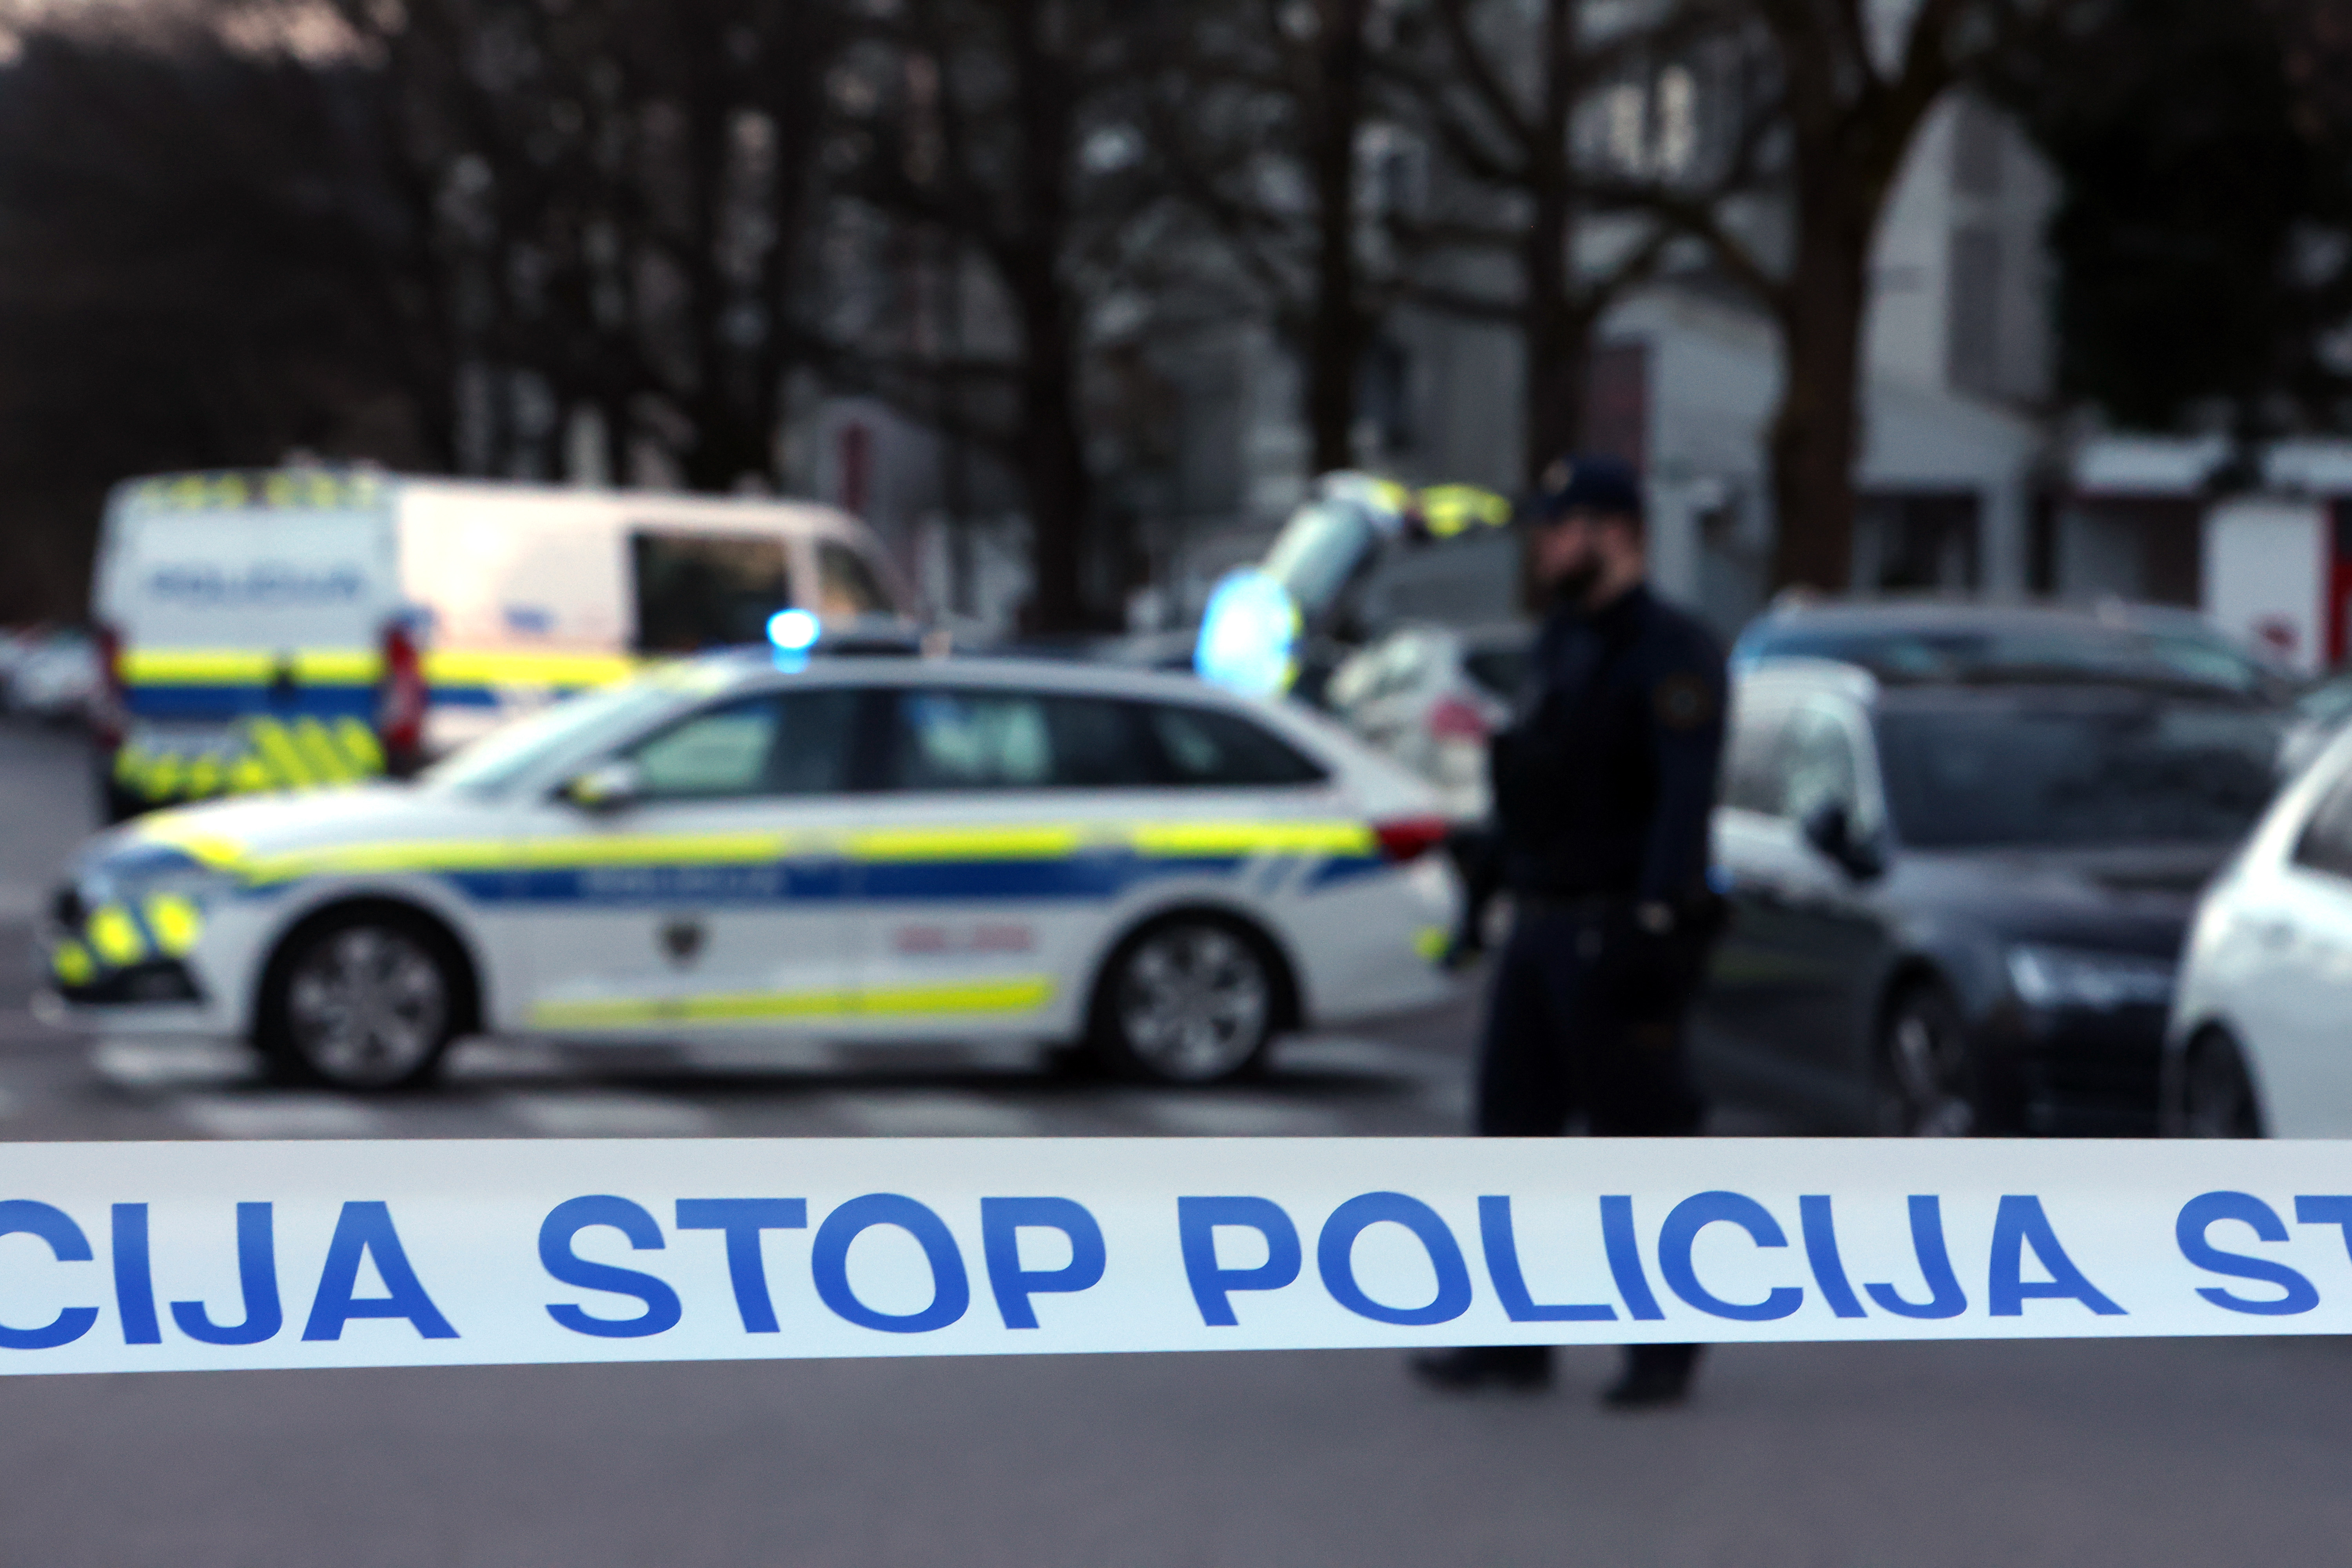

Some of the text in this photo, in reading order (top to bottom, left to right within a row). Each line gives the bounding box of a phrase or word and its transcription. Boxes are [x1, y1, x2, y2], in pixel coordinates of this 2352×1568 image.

[0, 1199, 461, 1350] CIJA
[538, 1192, 1106, 1338] STOP
[1178, 1190, 2129, 1327] POLICIJA
